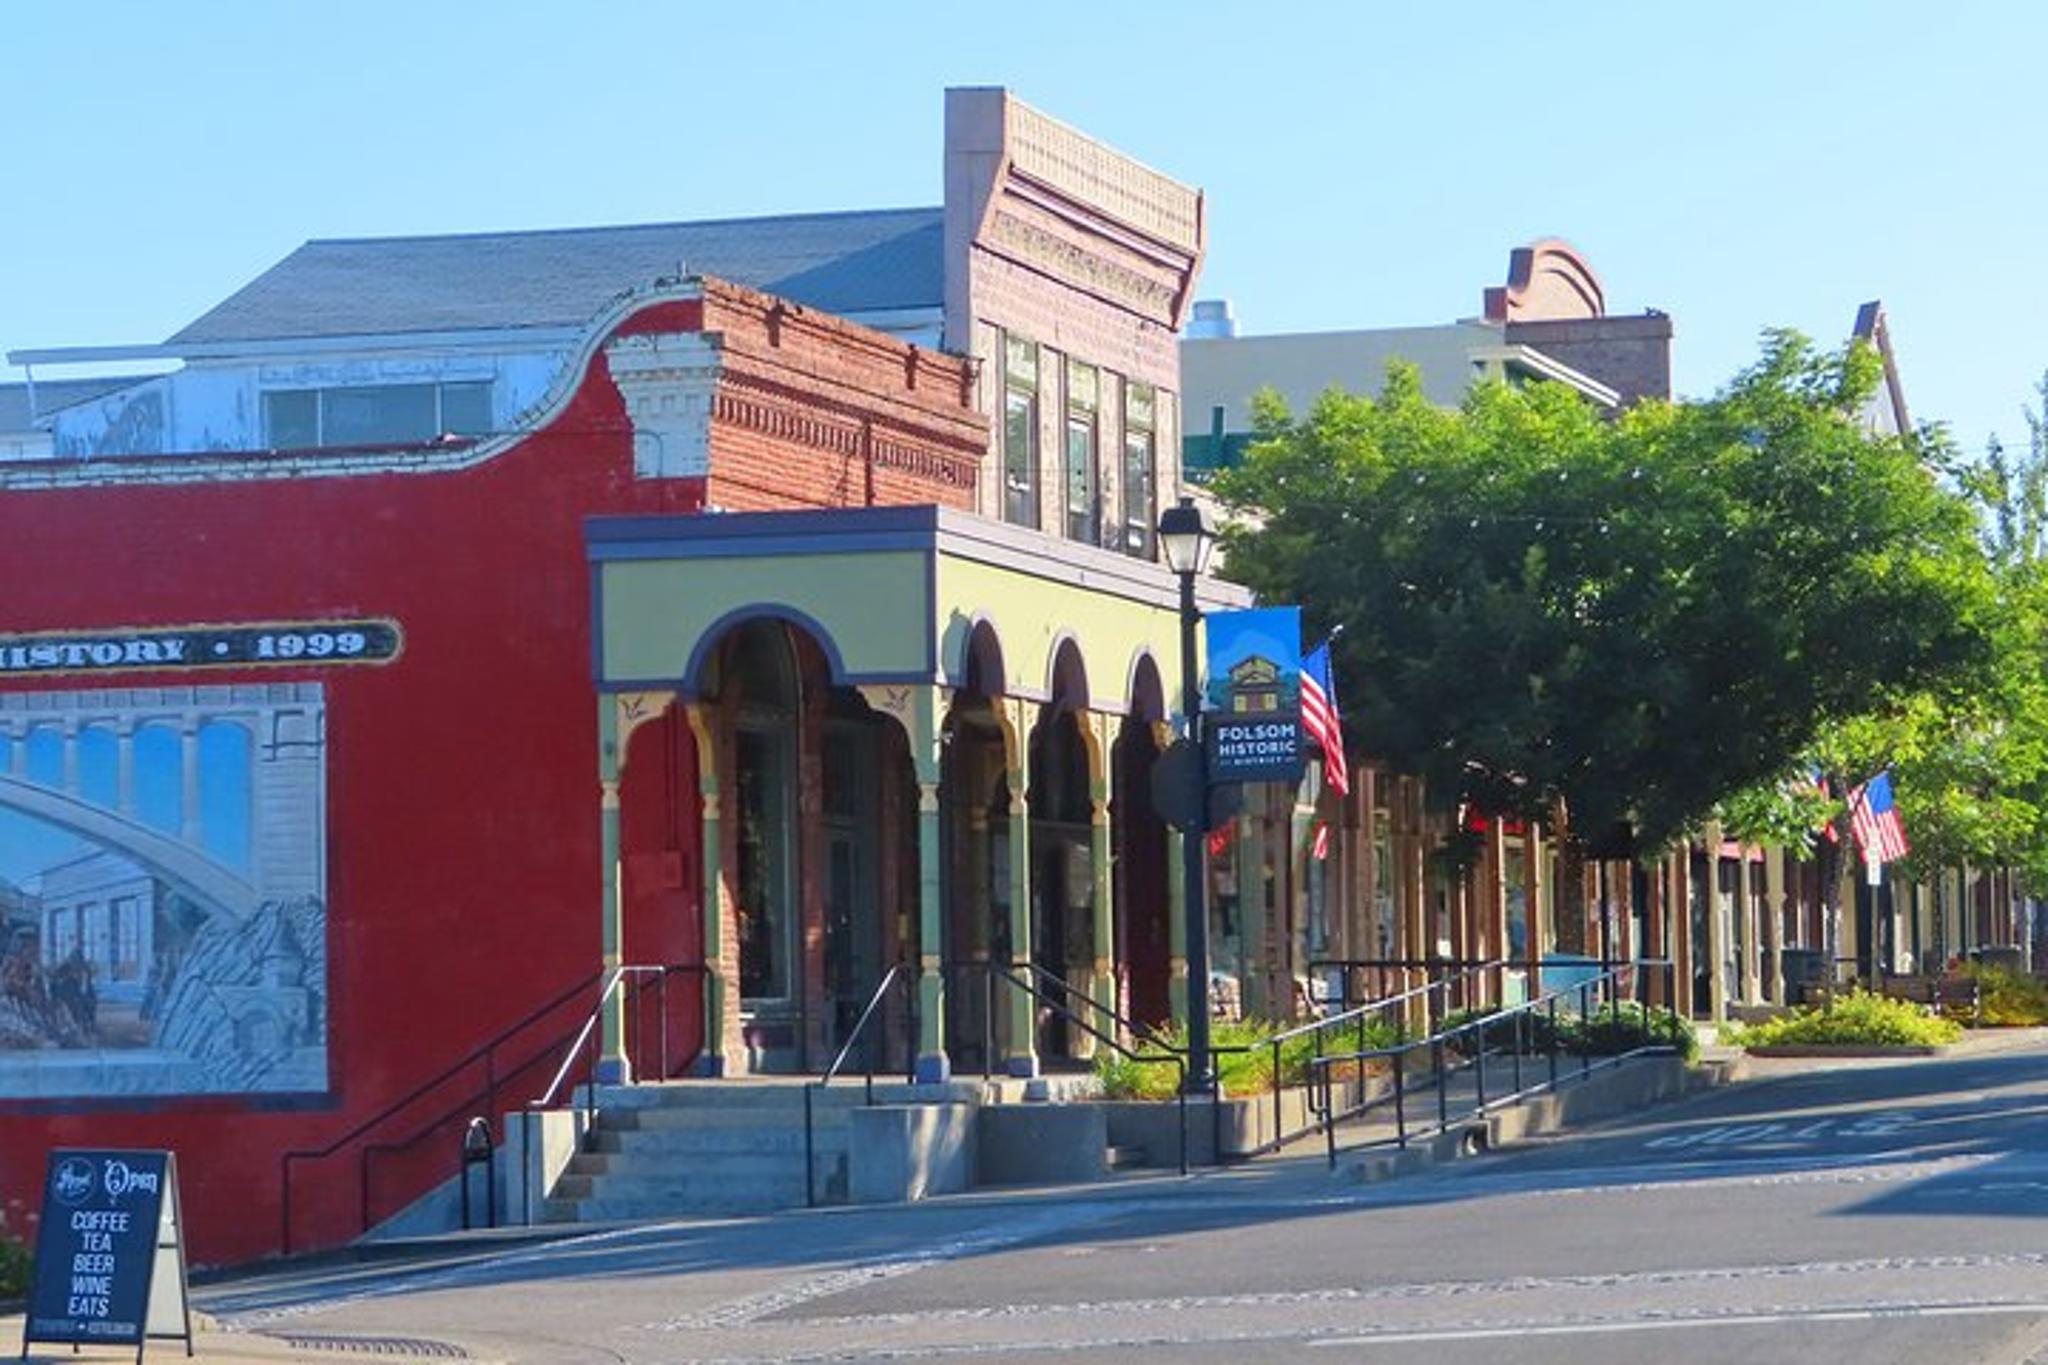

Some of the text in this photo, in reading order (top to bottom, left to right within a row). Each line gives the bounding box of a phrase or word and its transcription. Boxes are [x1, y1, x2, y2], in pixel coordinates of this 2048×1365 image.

[0, 633, 366, 669] ISTORY 1999
[1218, 724, 1295, 741] FOLSOM
[1219, 741, 1296, 756] HISTORIC
[71, 1211, 131, 1232] COFFEE
[82, 1232, 112, 1251] TEA
[73, 1254, 115, 1273] BEER
[71, 1276, 112, 1295] WINE
[68, 1297, 110, 1317] EATS
